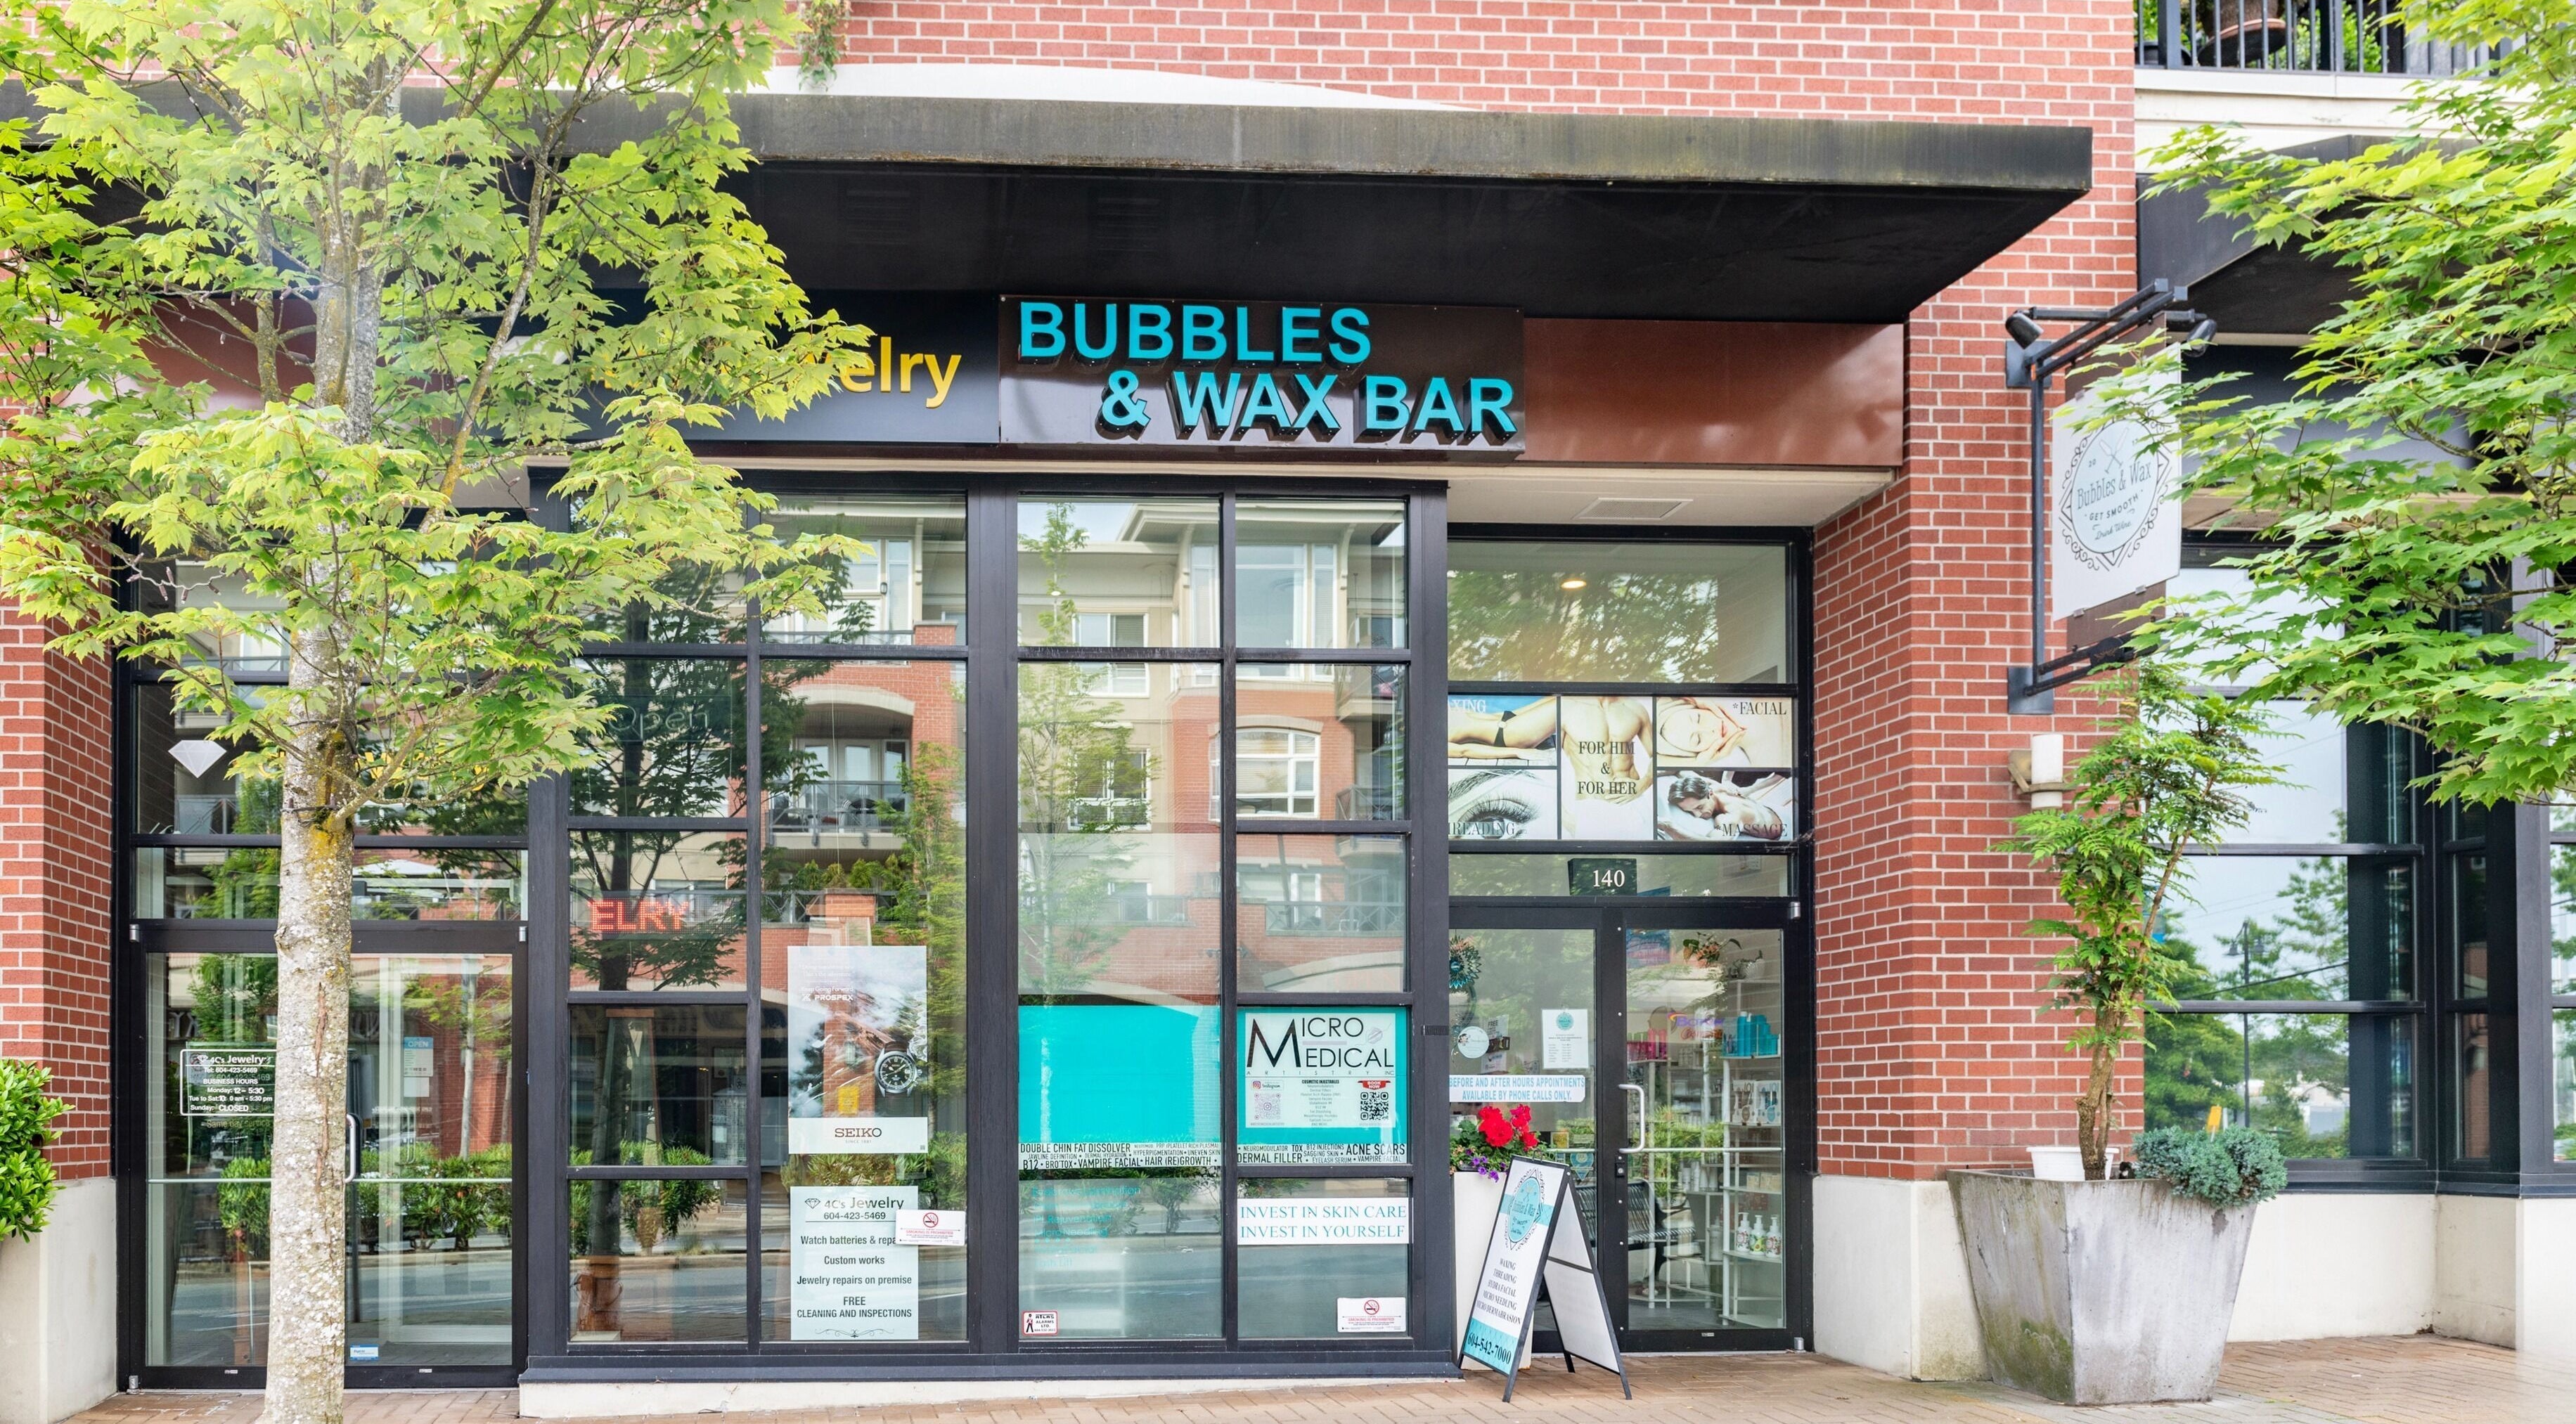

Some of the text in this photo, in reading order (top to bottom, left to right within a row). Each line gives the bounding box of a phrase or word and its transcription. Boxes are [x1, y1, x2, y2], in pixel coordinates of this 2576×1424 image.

[1019, 301, 1372, 365] BUBBLES
[1101, 370, 1518, 434] & WAX BAR
[2077, 460, 2151, 510] Bubbles & Wax
[2089, 493, 2139, 521] GET SMOOTH
[1448, 699, 1486, 713] XING
[1579, 741, 1635, 754] FOR HIM
[1600, 761, 1610, 775] &
[1578, 781, 1637, 794] FOR HER
[1592, 869, 1625, 887] 140
[590, 900, 690, 931] ELRY
[814, 994, 854, 1002] PROSPEX
[227, 1054, 266, 1066] Jewelry
[1449, 1077, 1585, 1087] BEFORE AND AFTER HOURS APPOINTMENTS
[1462, 1090, 1572, 1101] AVAILABLE BY PHONE CALLS ONLY.
[835, 1127, 882, 1138] SEIKO
[1020, 1143, 1051, 1153] DOUBLE
[1053, 1143, 1072, 1153] CHIN
[1074, 1143, 1086, 1153] FAT
[1088, 1143, 1131, 1153] DISSOLVER
[1346, 1143, 1405, 1156] ACNE SCARS
[1023, 1159, 1038, 1170] B12
[1078, 1158, 1112, 1168] VAMPIRE
[1114, 1158, 1141, 1167] FACIAL
[1145, 1156, 1162, 1165] HAIR
[1165, 1156, 1211, 1166] (RE)GROWTH
[1237, 1153, 1303, 1163] DERMAL FILLER
[824, 1196, 904, 1210] 4C's Jewelry
[823, 1212, 886, 1220] 604-423-5469
[1240, 1205, 1406, 1219] INVEST IN SKIN CARE
[1240, 1225, 1405, 1238] INVEST IN YOURSELF
[800, 1236, 827, 1245] Watch
[830, 1236, 867, 1245] batteries
[869, 1236, 876, 1245] &
[878, 1237, 896, 1246] repa
[824, 1255, 885, 1264] Custom works
[797, 1276, 830, 1286] Jewelry
[832, 1276, 863, 1286] repairs
[878, 1275, 912, 1286] premise
[1493, 1268, 1517, 1284] THREADING
[843, 1296, 865, 1305] FREE
[797, 1309, 912, 1318] CLEANING AND INSPECTIONS
[1467, 1332, 1512, 1365] 604-542-7000
